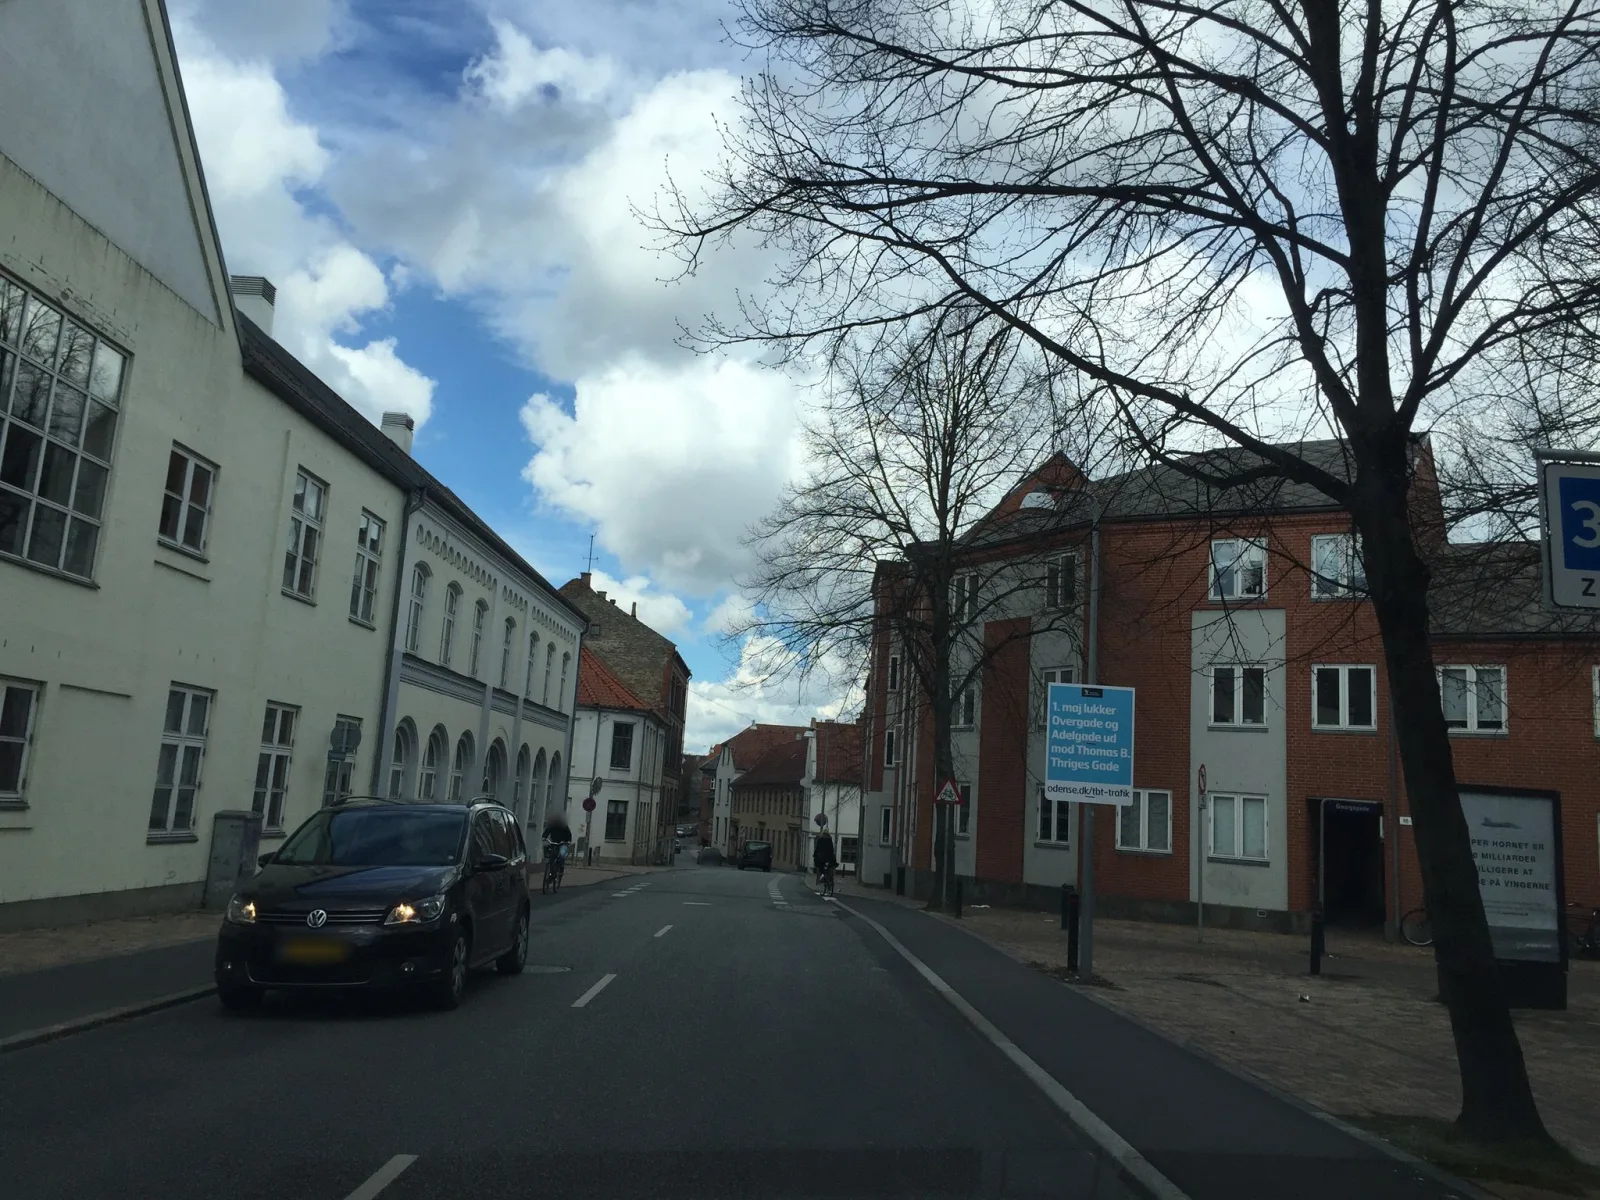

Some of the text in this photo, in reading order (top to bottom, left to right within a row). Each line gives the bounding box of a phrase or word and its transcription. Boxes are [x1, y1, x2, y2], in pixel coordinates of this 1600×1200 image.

[1052, 701, 1117, 715] 1. maj lukker
[1051, 715, 1119, 731] Overgade og
[1051, 729, 1117, 743] Adelgade ud
[1051, 744, 1131, 758] mod Thomas B.
[1050, 757, 1119, 772] Thriges Gade
[1047, 784, 1130, 798] odense.dk/tbt-trafik
[1471, 838, 1544, 851] PER HORNET ER
[1481, 852, 1536, 863] MILLIARDER
[1477, 865, 1534, 876] ILLIGERE AT
[1490, 878, 1501, 887] PÅ
[1504, 880, 1550, 890] VINGERNE
